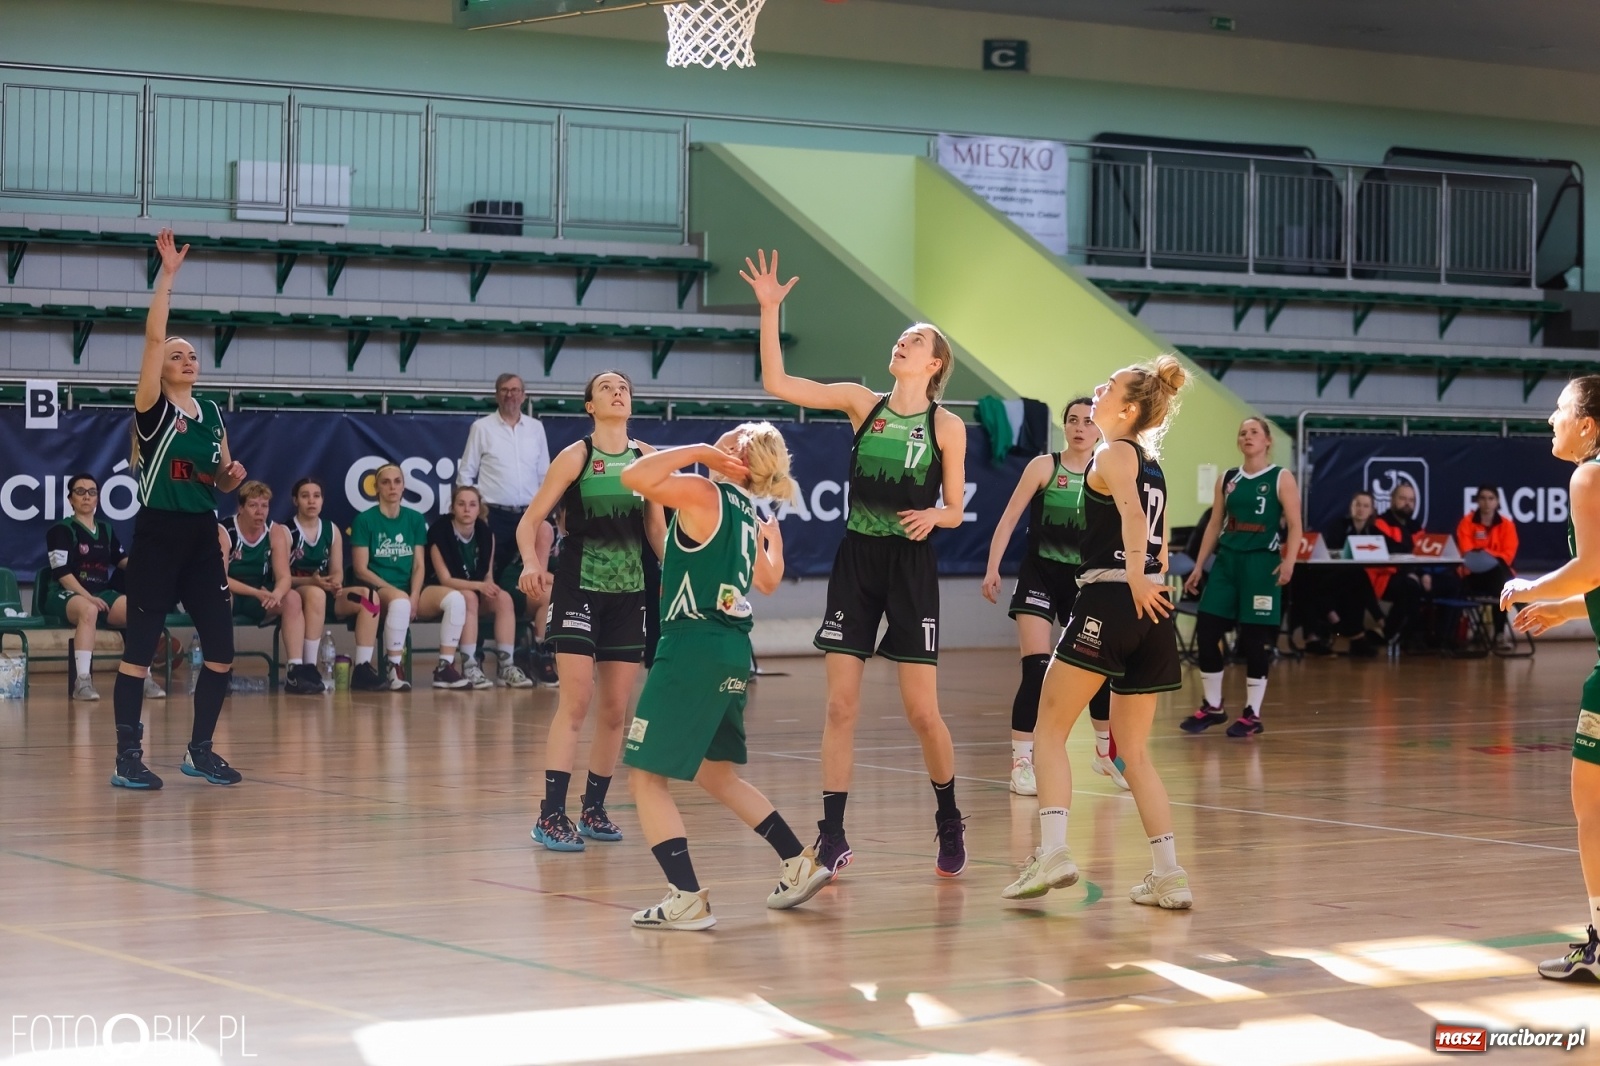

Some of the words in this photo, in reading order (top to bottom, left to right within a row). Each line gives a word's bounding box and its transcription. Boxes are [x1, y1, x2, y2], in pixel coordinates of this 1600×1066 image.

[991, 49, 1016, 67] C
[953, 143, 1054, 171] MIESZKO
[30, 389, 55, 418] B
[904, 441, 927, 469] 17
[344, 455, 464, 516] OSi
[1143, 482, 1165, 545] 12
[1254, 496, 1266, 515] 3
[921, 623, 935, 652] 17
[1076, 632, 1102, 647] ASPERGO
[1576, 737, 1596, 748] COLO
